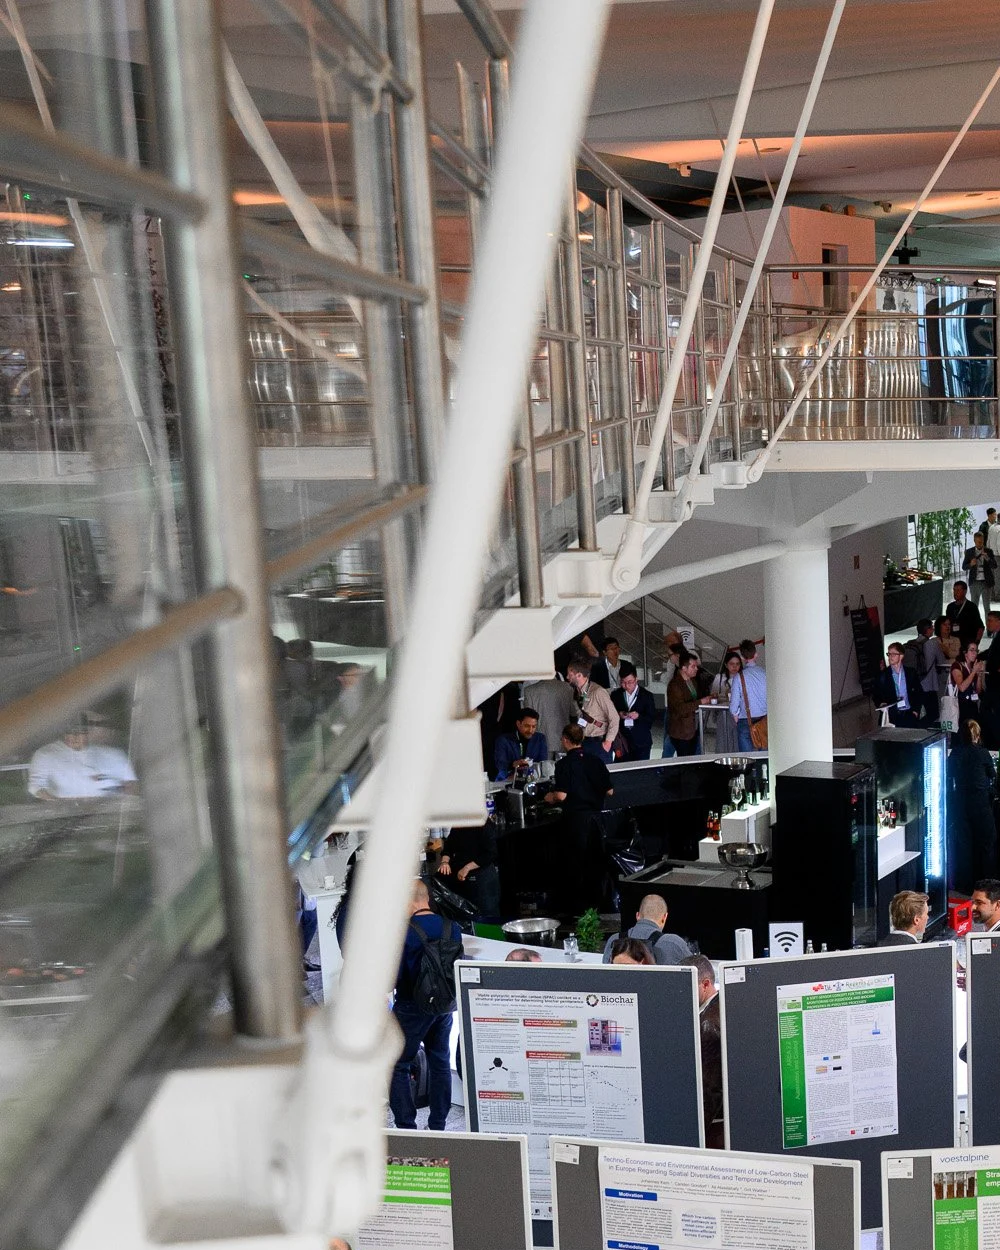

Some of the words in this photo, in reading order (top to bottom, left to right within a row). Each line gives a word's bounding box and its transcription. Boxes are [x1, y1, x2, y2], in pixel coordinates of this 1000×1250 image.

[601, 996, 634, 1004] Biochar
[940, 1153, 990, 1164] voestalpine
[604, 1156, 654, 1167] Techno-Economic
[656, 1160, 666, 1168] and
[668, 1161, 709, 1171] Environmental
[710, 1165, 747, 1174] Assessment
[755, 1169, 791, 1178] Low-Carbon
[616, 1166, 636, 1174] Europe
[638, 1167, 667, 1176] Regarding
[669, 1169, 688, 1177] Spatial
[690, 1171, 720, 1180] Diversities
[735, 1175, 761, 1184] Temporal
[763, 1177, 803, 1187] Development
[619, 1191, 643, 1199] Motivation
